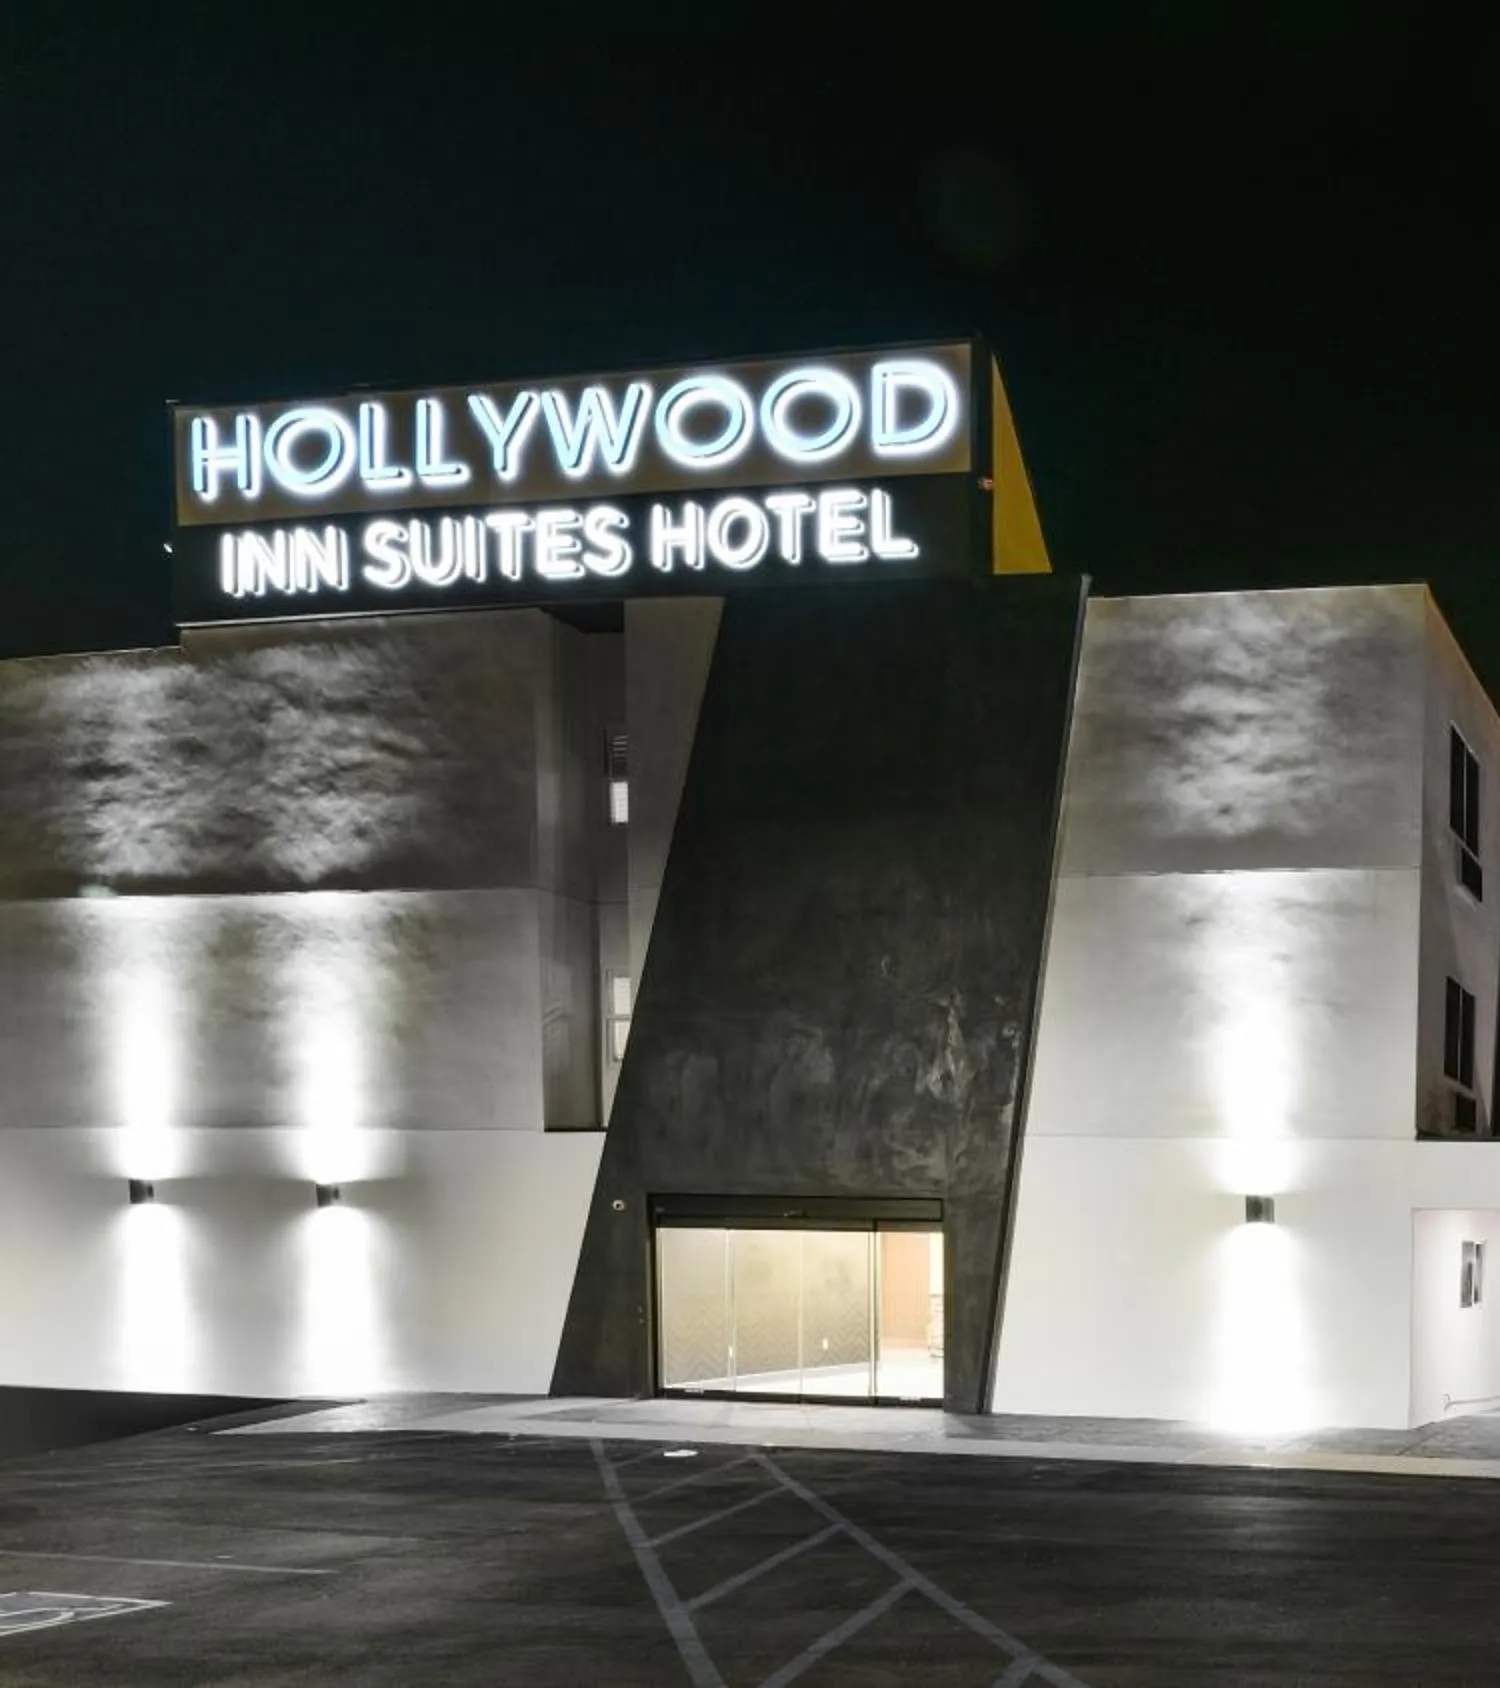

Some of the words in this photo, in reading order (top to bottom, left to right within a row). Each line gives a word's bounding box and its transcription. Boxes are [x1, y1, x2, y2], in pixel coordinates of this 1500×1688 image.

[190, 361, 959, 502] HOLLYWOOD
[220, 524, 350, 598] INN
[362, 507, 632, 589] SUITES
[648, 488, 920, 572] HOTEL
